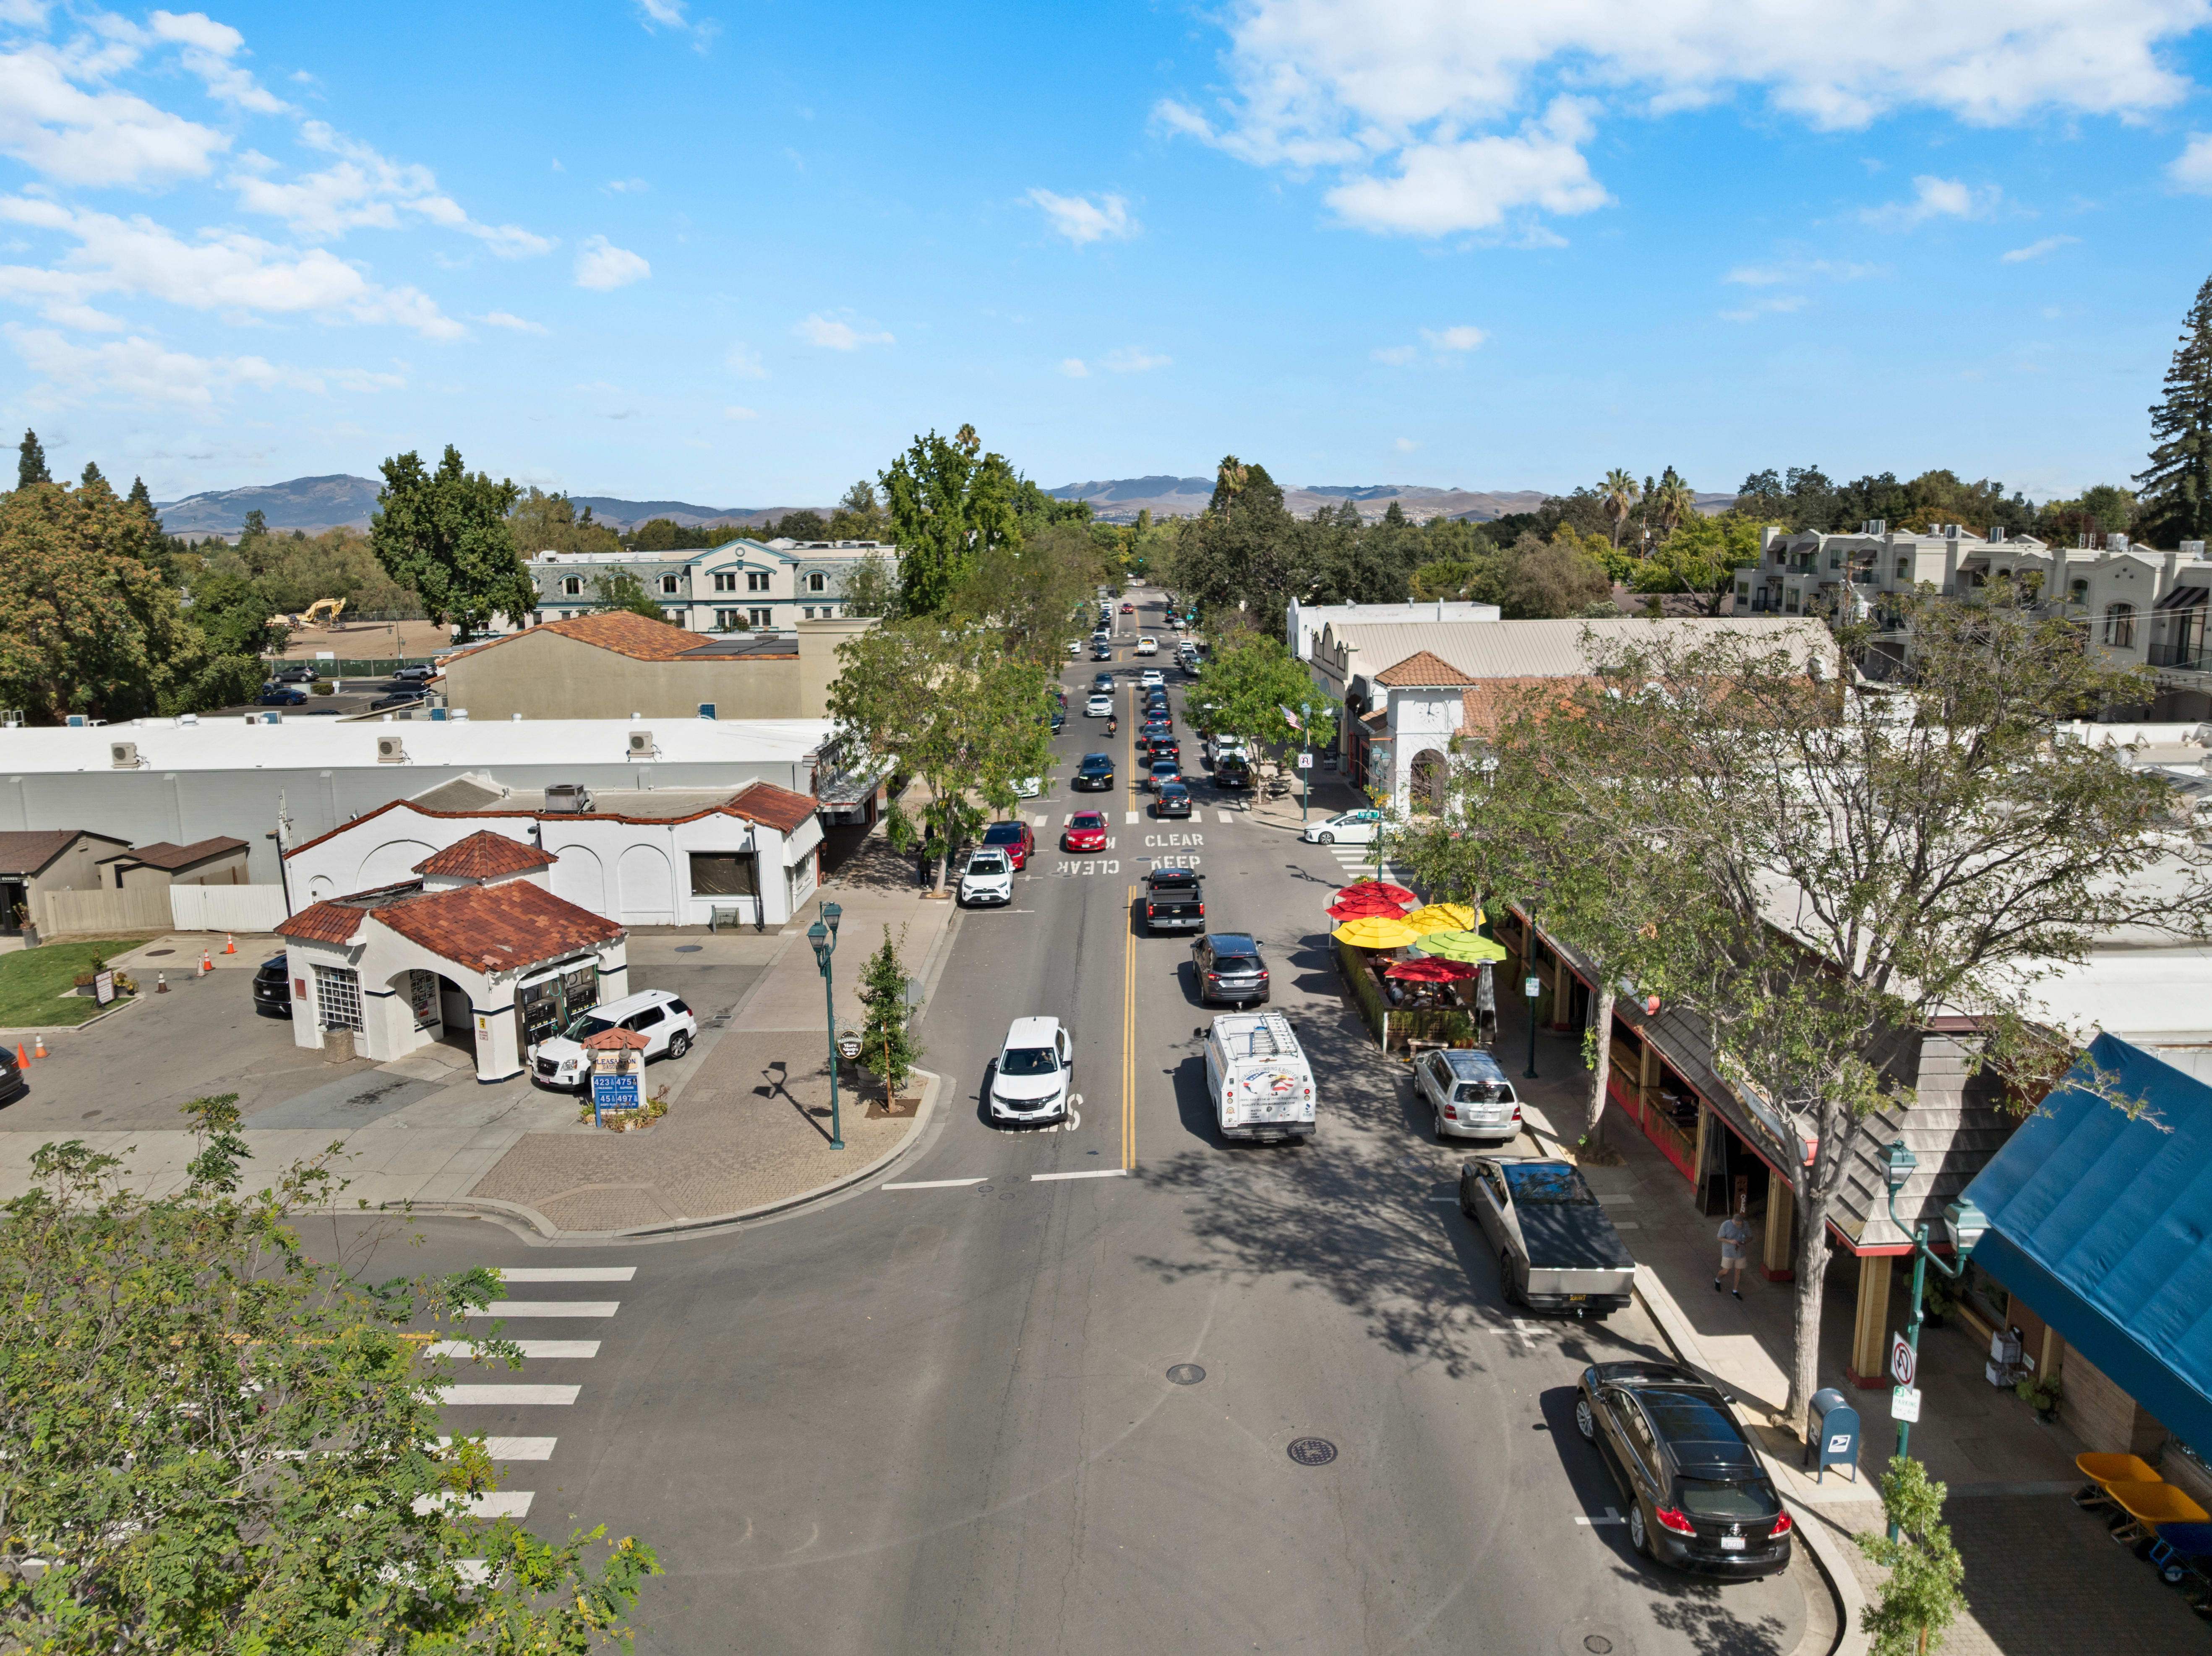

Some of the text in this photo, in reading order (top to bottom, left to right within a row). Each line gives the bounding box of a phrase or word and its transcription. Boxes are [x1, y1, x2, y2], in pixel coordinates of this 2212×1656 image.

[1145, 834, 1204, 847] CLEAR
[1057, 860, 1119, 875] CLEAR
[1151, 856, 1201, 871] KEEP
[1239, 1070, 1255, 1083] QUALITY
[1282, 1068, 1299, 1081] ROOTER
[1894, 1398, 1917, 1409] PARKING
